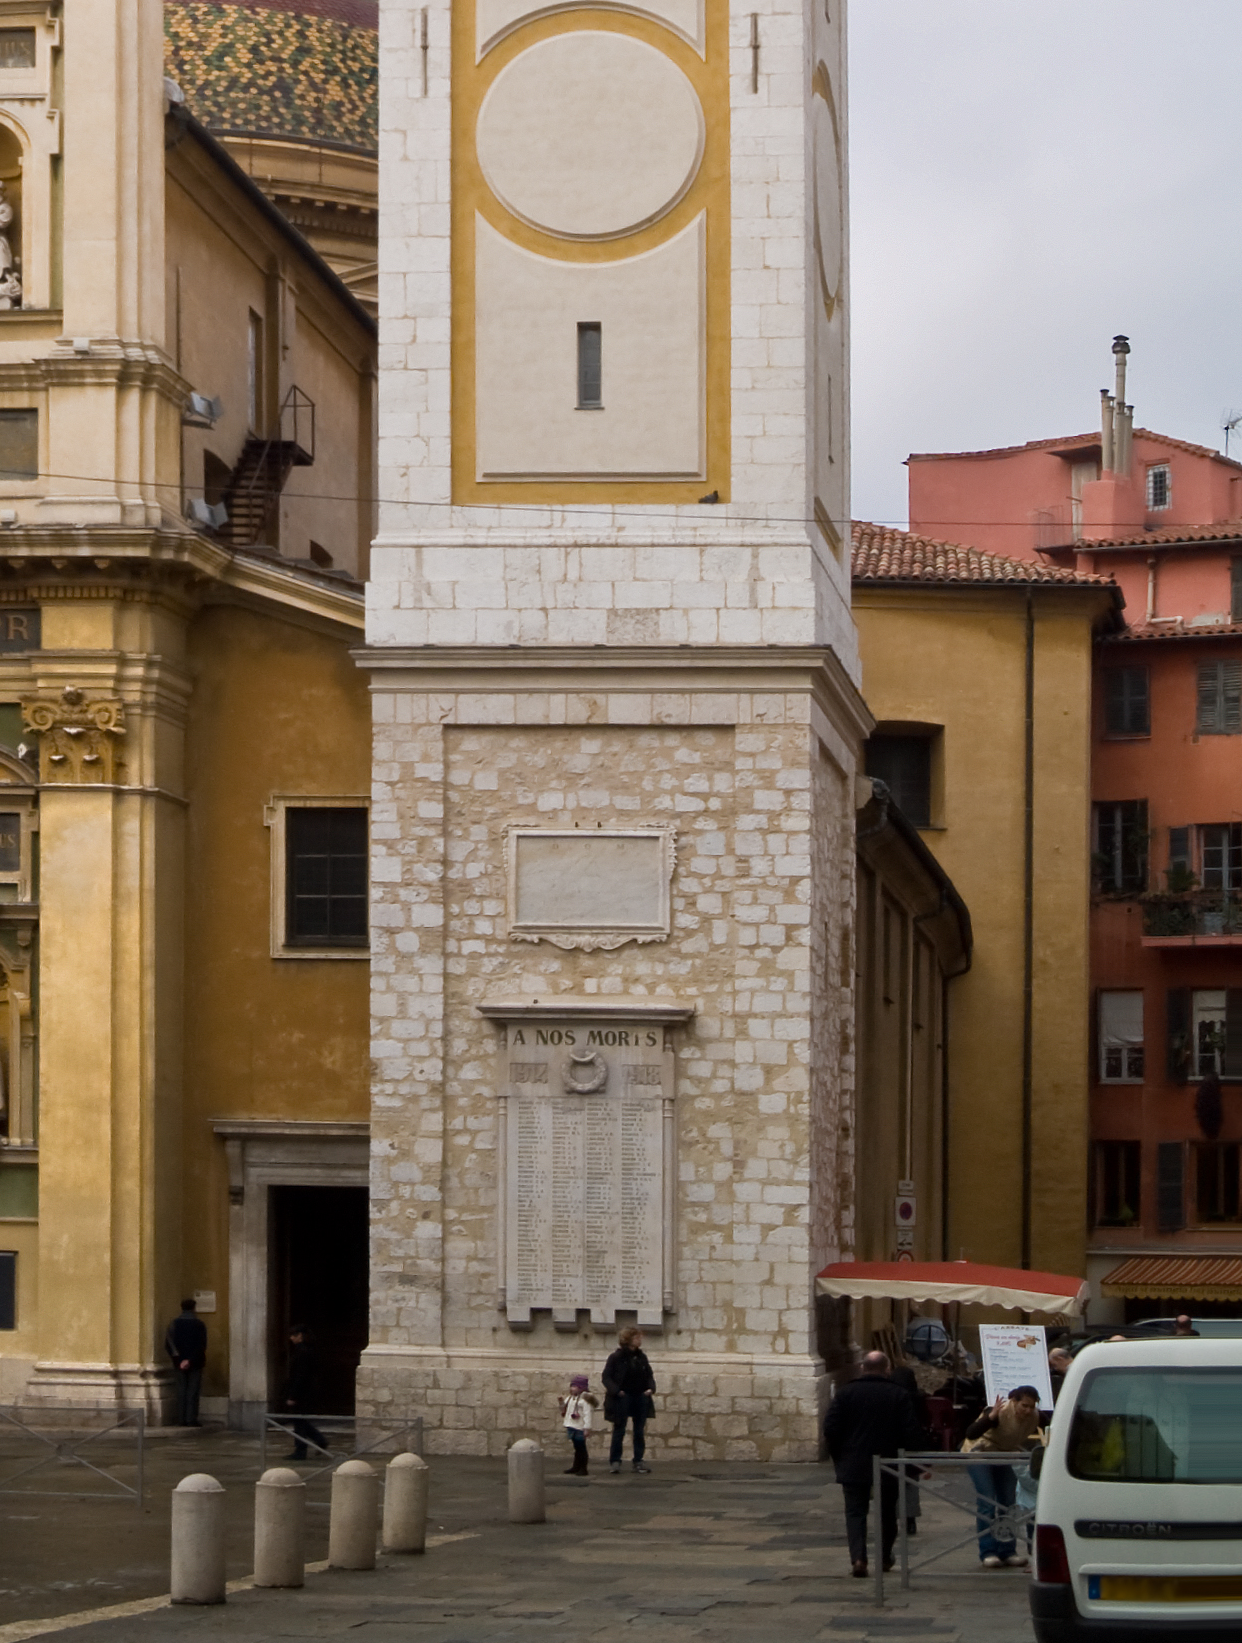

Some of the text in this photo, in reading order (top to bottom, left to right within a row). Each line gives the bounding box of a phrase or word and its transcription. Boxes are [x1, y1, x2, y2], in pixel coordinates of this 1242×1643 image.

[513, 1030, 526, 1046] A
[536, 1030, 577, 1047] NOS
[1088, 1521, 1172, 1536] CITROËN
